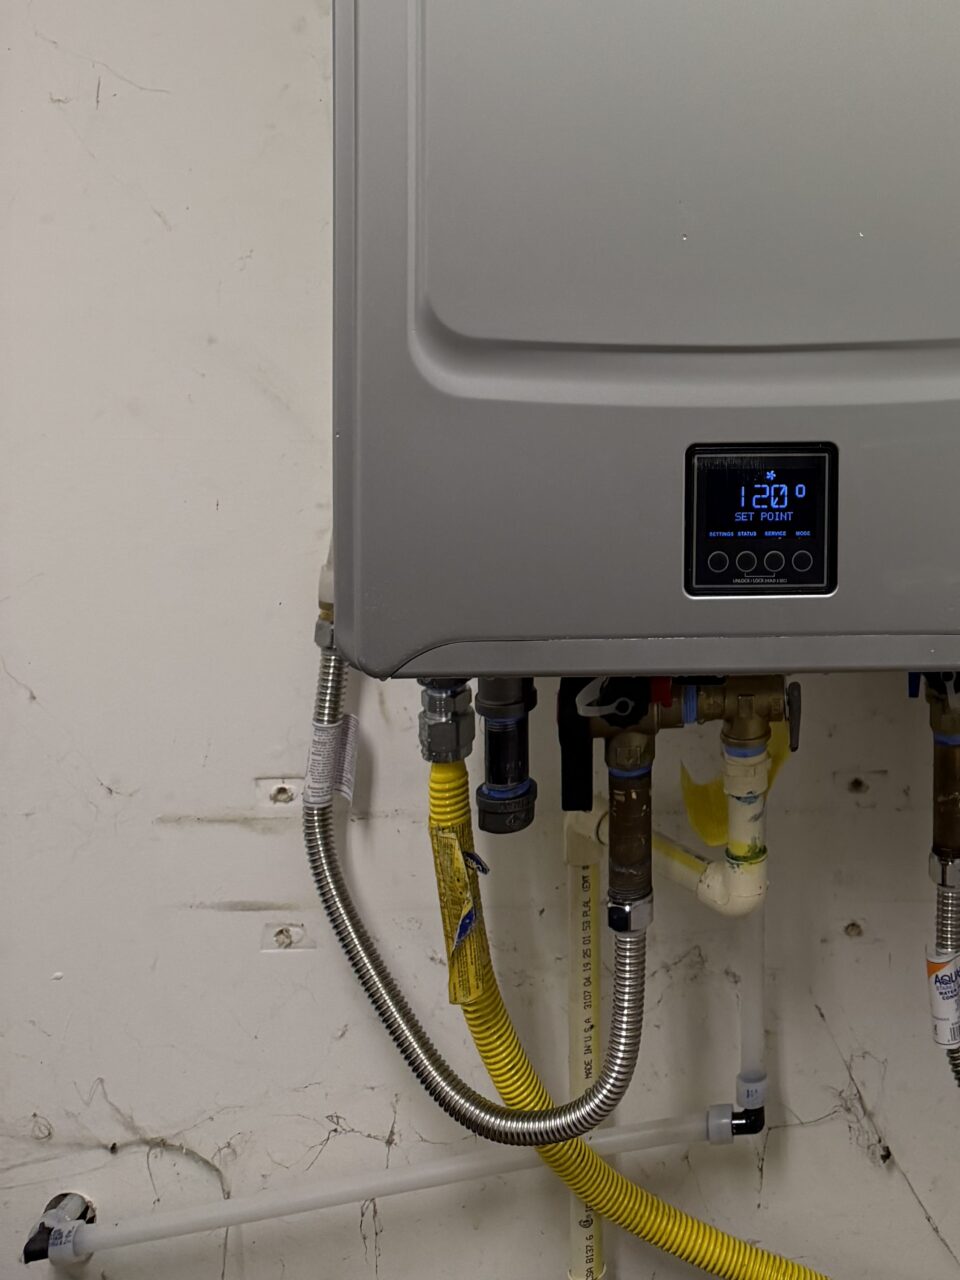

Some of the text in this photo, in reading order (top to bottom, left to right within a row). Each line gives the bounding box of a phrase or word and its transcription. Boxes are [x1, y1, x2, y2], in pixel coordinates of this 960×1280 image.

[735, 511, 794, 521] SET POINT
[584, 1059, 593, 1080] MADE
